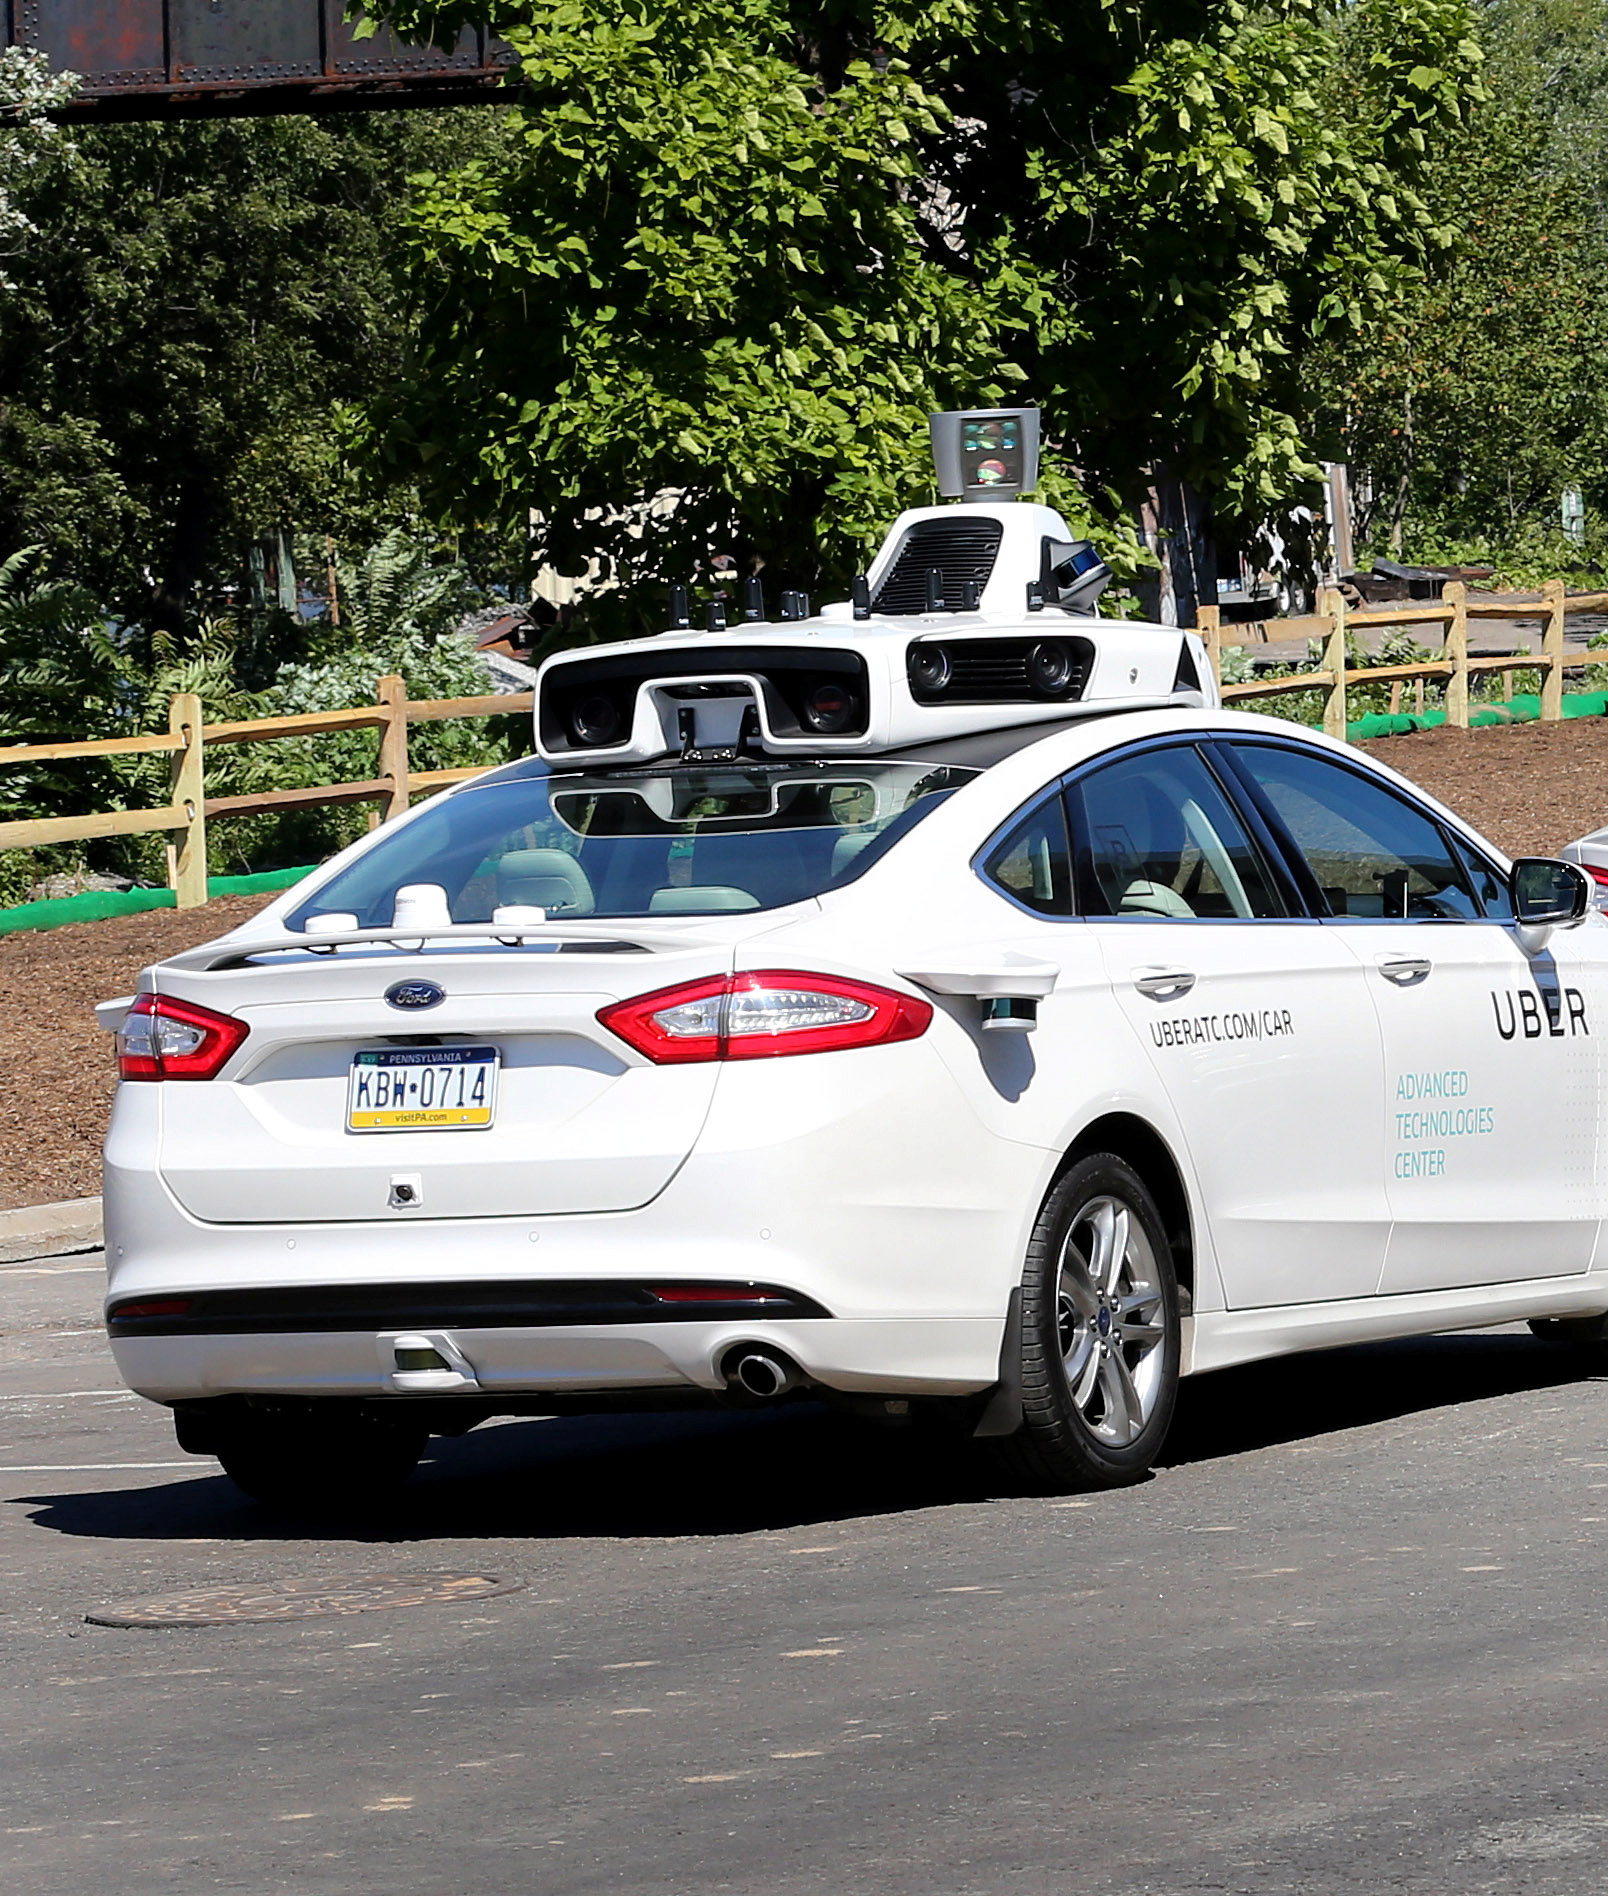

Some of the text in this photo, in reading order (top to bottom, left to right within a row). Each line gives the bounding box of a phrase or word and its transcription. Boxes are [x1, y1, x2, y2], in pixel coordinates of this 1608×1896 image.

[395, 985, 433, 1005] Ford
[1149, 1008, 1295, 1049] UBERATC.COM/CAR
[1490, 988, 1591, 1041] UBER
[388, 1053, 463, 1065] PENNSYLVANIA
[1395, 1070, 1469, 1101] ADVANCED
[395, 1112, 448, 1123] visitPA.com
[1395, 1106, 1495, 1140] TECHNOLOGIES
[1393, 1149, 1447, 1179] CENTER
